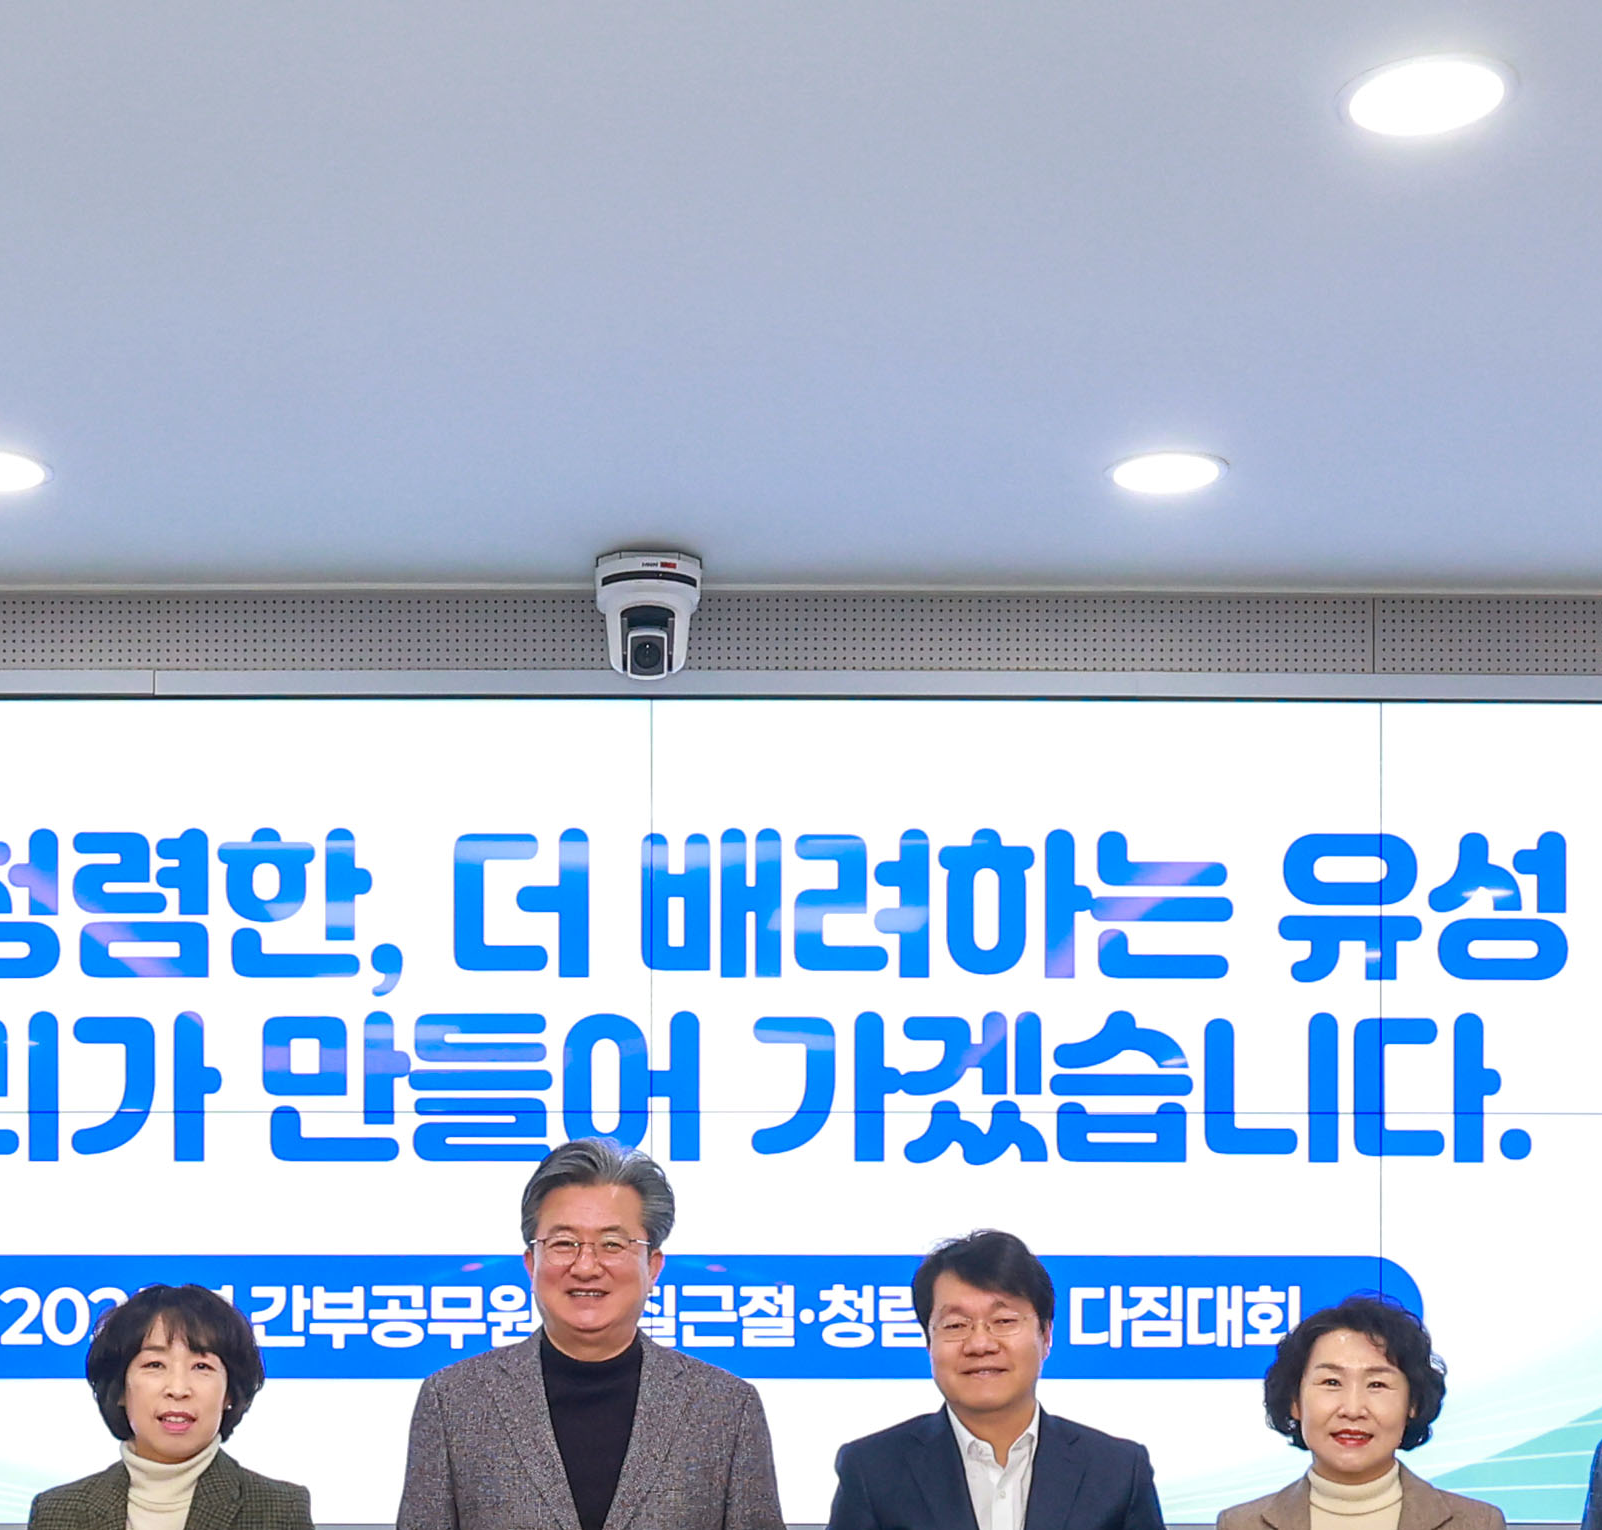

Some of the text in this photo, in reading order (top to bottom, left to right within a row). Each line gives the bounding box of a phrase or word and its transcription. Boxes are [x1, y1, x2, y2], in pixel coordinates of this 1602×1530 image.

[451, 831, 596, 981] 더
[636, 828, 1236, 984] 배려하는
[1276, 831, 1570, 984] 유성
[260, 1009, 701, 1162] 만들어
[751, 1009, 1532, 1166] 가겠습니다.
[1069, 1284, 1301, 1350] 다짐대회
